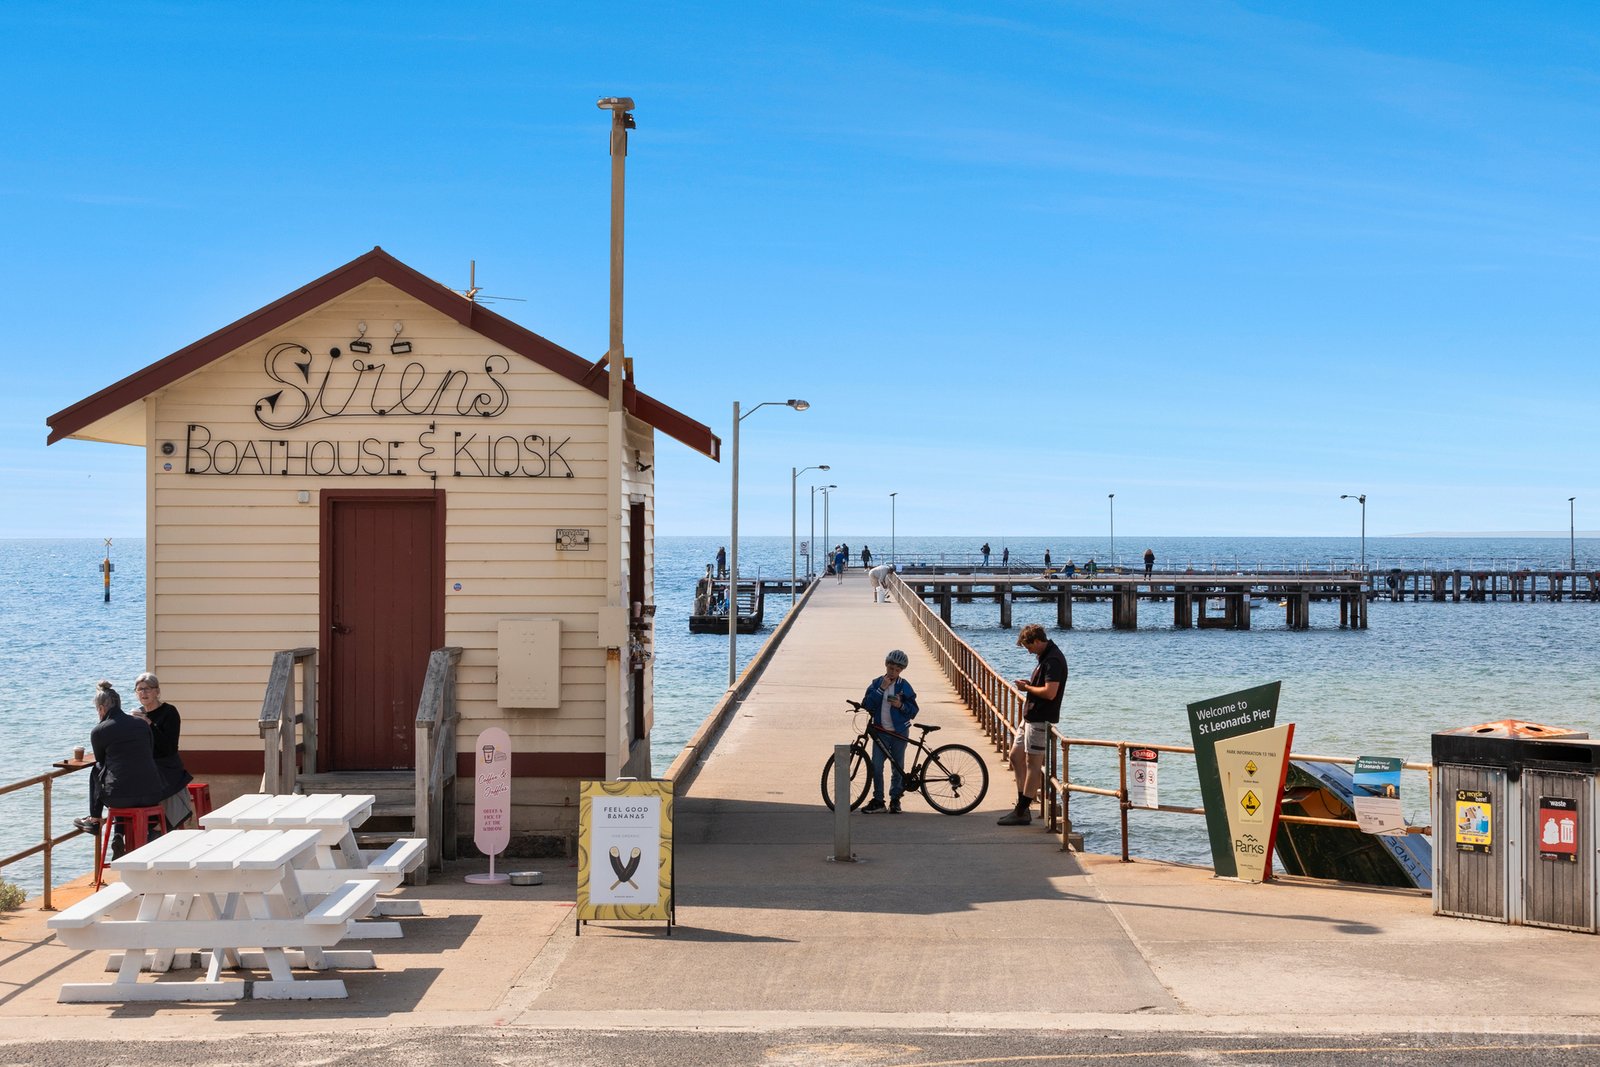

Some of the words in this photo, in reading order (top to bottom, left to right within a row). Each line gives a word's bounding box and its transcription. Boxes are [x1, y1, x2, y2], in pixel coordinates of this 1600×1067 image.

[255, 342, 510, 431] Sirens
[186, 424, 407, 476] BOATHOUSE
[417, 421, 437, 482] &
[453, 431, 575, 478] KIOSK
[1196, 703, 1236, 721] Welcome
[1237, 701, 1248, 710] to
[1199, 724, 1209, 735] St
[1210, 713, 1252, 732] Leonards
[1252, 709, 1271, 721] Pier
[1235, 840, 1265, 855] Parks
[1383, 836, 1422, 881] TENDE
